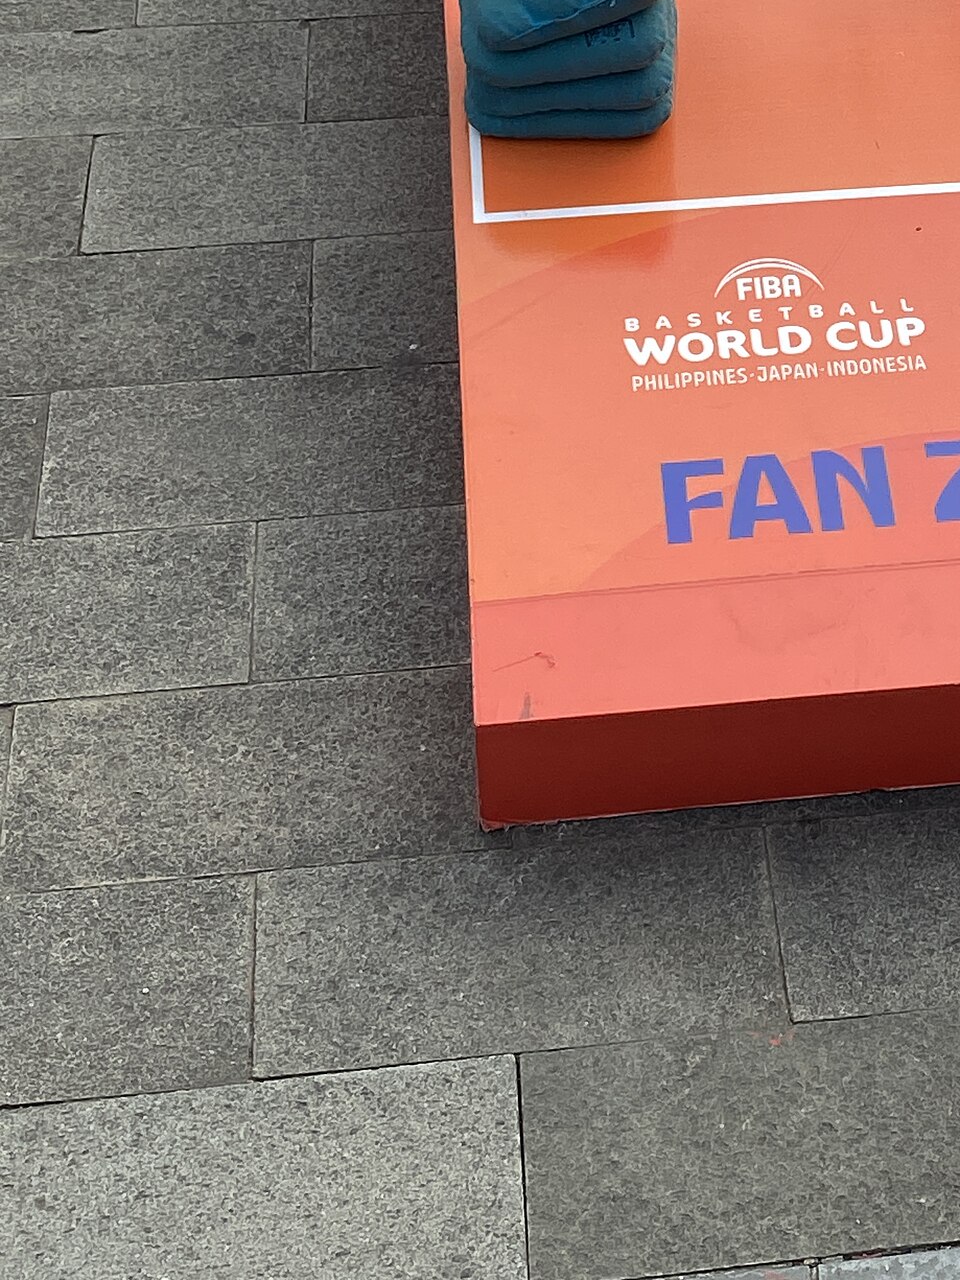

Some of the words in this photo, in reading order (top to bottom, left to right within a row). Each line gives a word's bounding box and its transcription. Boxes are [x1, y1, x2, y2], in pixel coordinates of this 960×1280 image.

[736, 274, 802, 301] FIBA
[624, 298, 914, 332] BASKETBALL
[622, 325, 812, 366] WORLD
[825, 317, 926, 351] CUP
[660, 445, 897, 545] FAN
